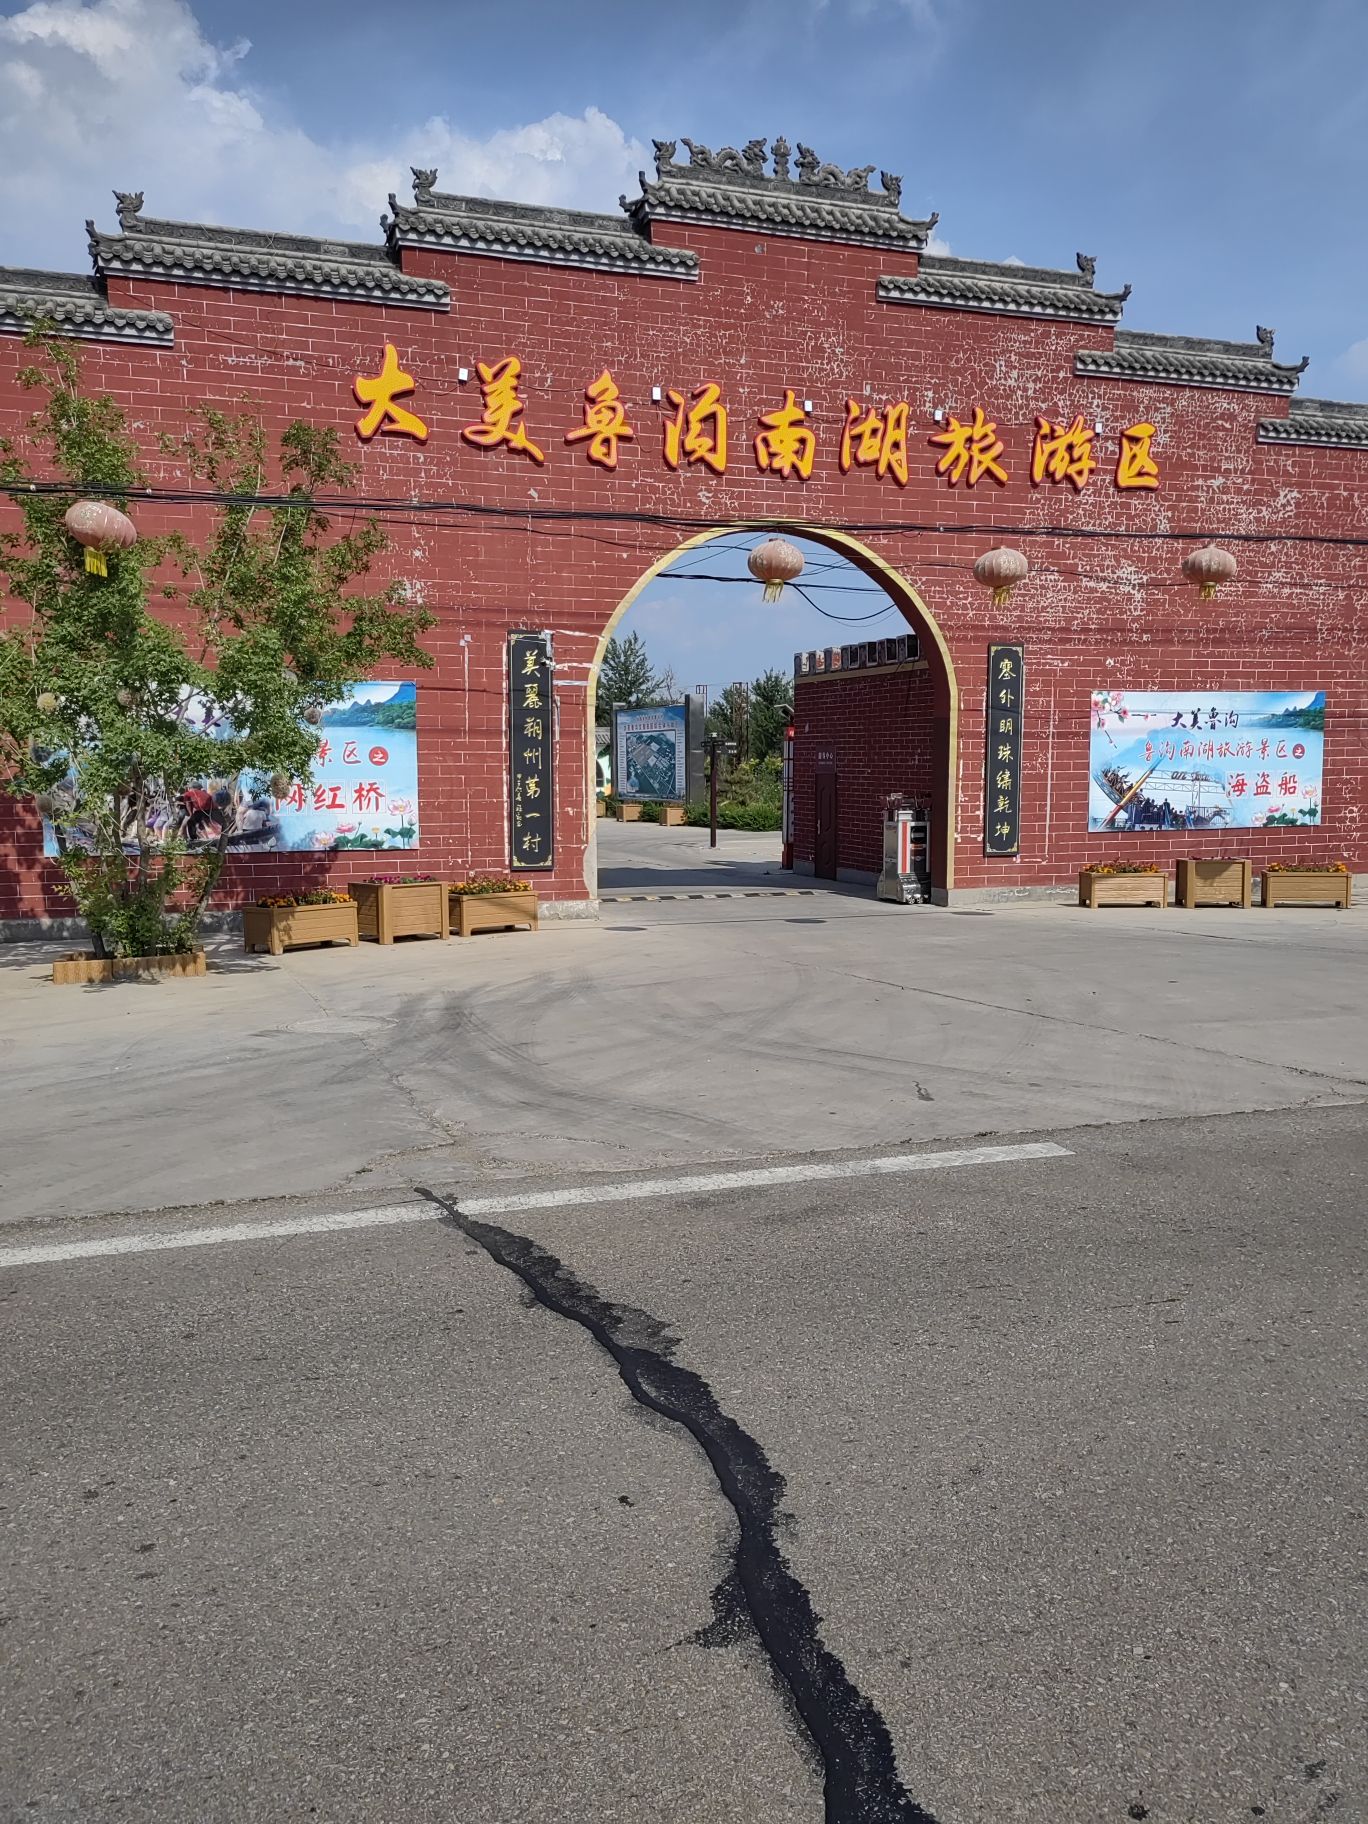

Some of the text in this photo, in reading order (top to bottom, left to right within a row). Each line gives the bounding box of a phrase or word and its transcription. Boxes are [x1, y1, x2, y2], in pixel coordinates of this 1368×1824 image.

[353, 342, 1160, 490] 大美鲁沟南湖旅游区
[1227, 771, 1299, 798] 海盗船
